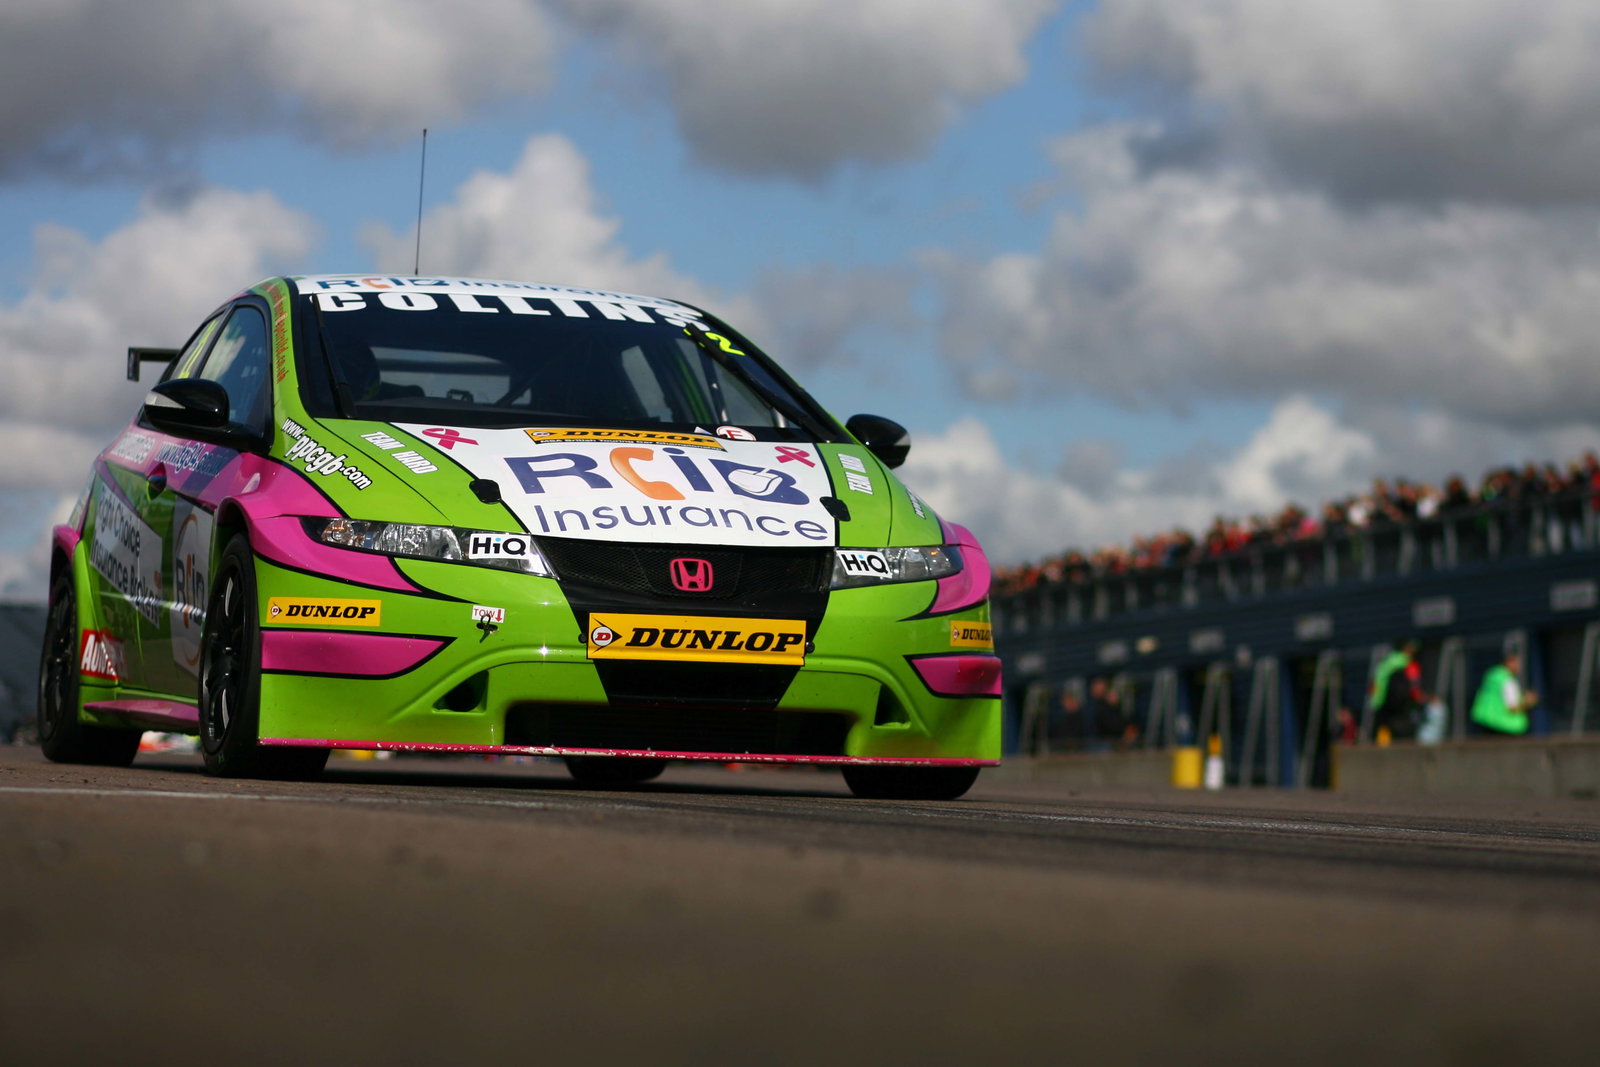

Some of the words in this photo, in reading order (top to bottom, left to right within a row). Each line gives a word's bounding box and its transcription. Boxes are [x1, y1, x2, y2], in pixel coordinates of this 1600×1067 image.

[310, 292, 711, 332] COLLINS
[683, 328, 746, 356] 2
[563, 431, 716, 443] DUNLOP
[281, 417, 373, 491] www.ppcgb.com
[360, 431, 406, 451] TEAM
[391, 450, 439, 475] HARD
[534, 504, 829, 541] Insurance
[472, 537, 527, 557] HiQ
[841, 553, 889, 574] HiQ
[285, 604, 377, 619] DUNLOP
[473, 608, 496, 618] TOW
[625, 627, 804, 652] DUNLOP
